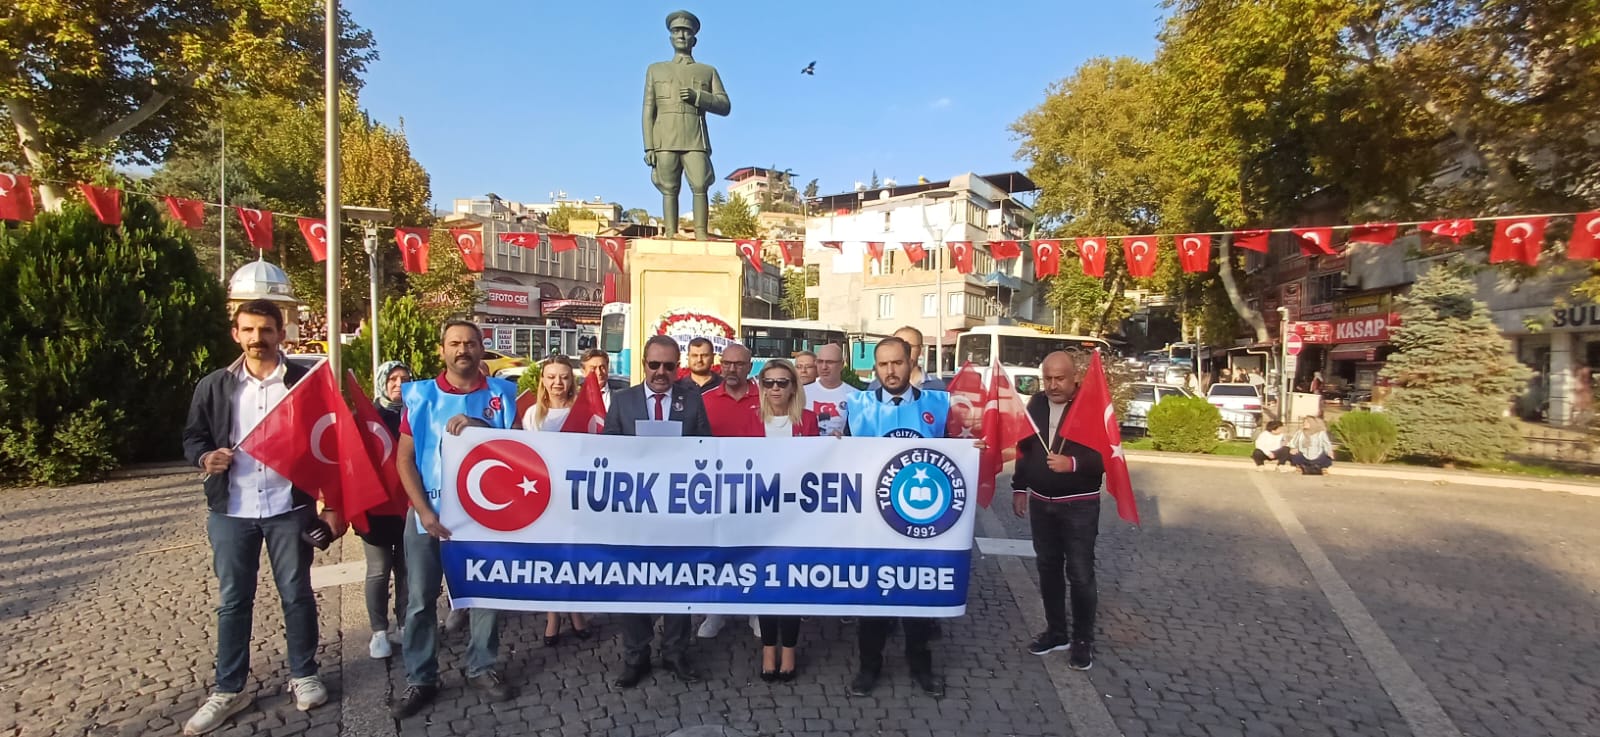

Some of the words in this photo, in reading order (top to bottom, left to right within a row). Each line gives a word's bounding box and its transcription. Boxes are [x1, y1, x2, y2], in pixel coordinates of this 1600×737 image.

[495, 292, 514, 303] FOTO
[1336, 319, 1385, 339] KASAP
[565, 458, 660, 514] TÜRK
[668, 458, 863, 515] EĞİTİM-SEN
[877, 463, 900, 511] TÜRK
[900, 449, 965, 511] EĞİTİM-SEN
[906, 525, 937, 537] 1992
[465, 559, 758, 594] KAHRAMANMARAŞ
[764, 563, 781, 587] 1
[787, 564, 870, 589] NOLU
[876, 566, 955, 597] ŞUBE
